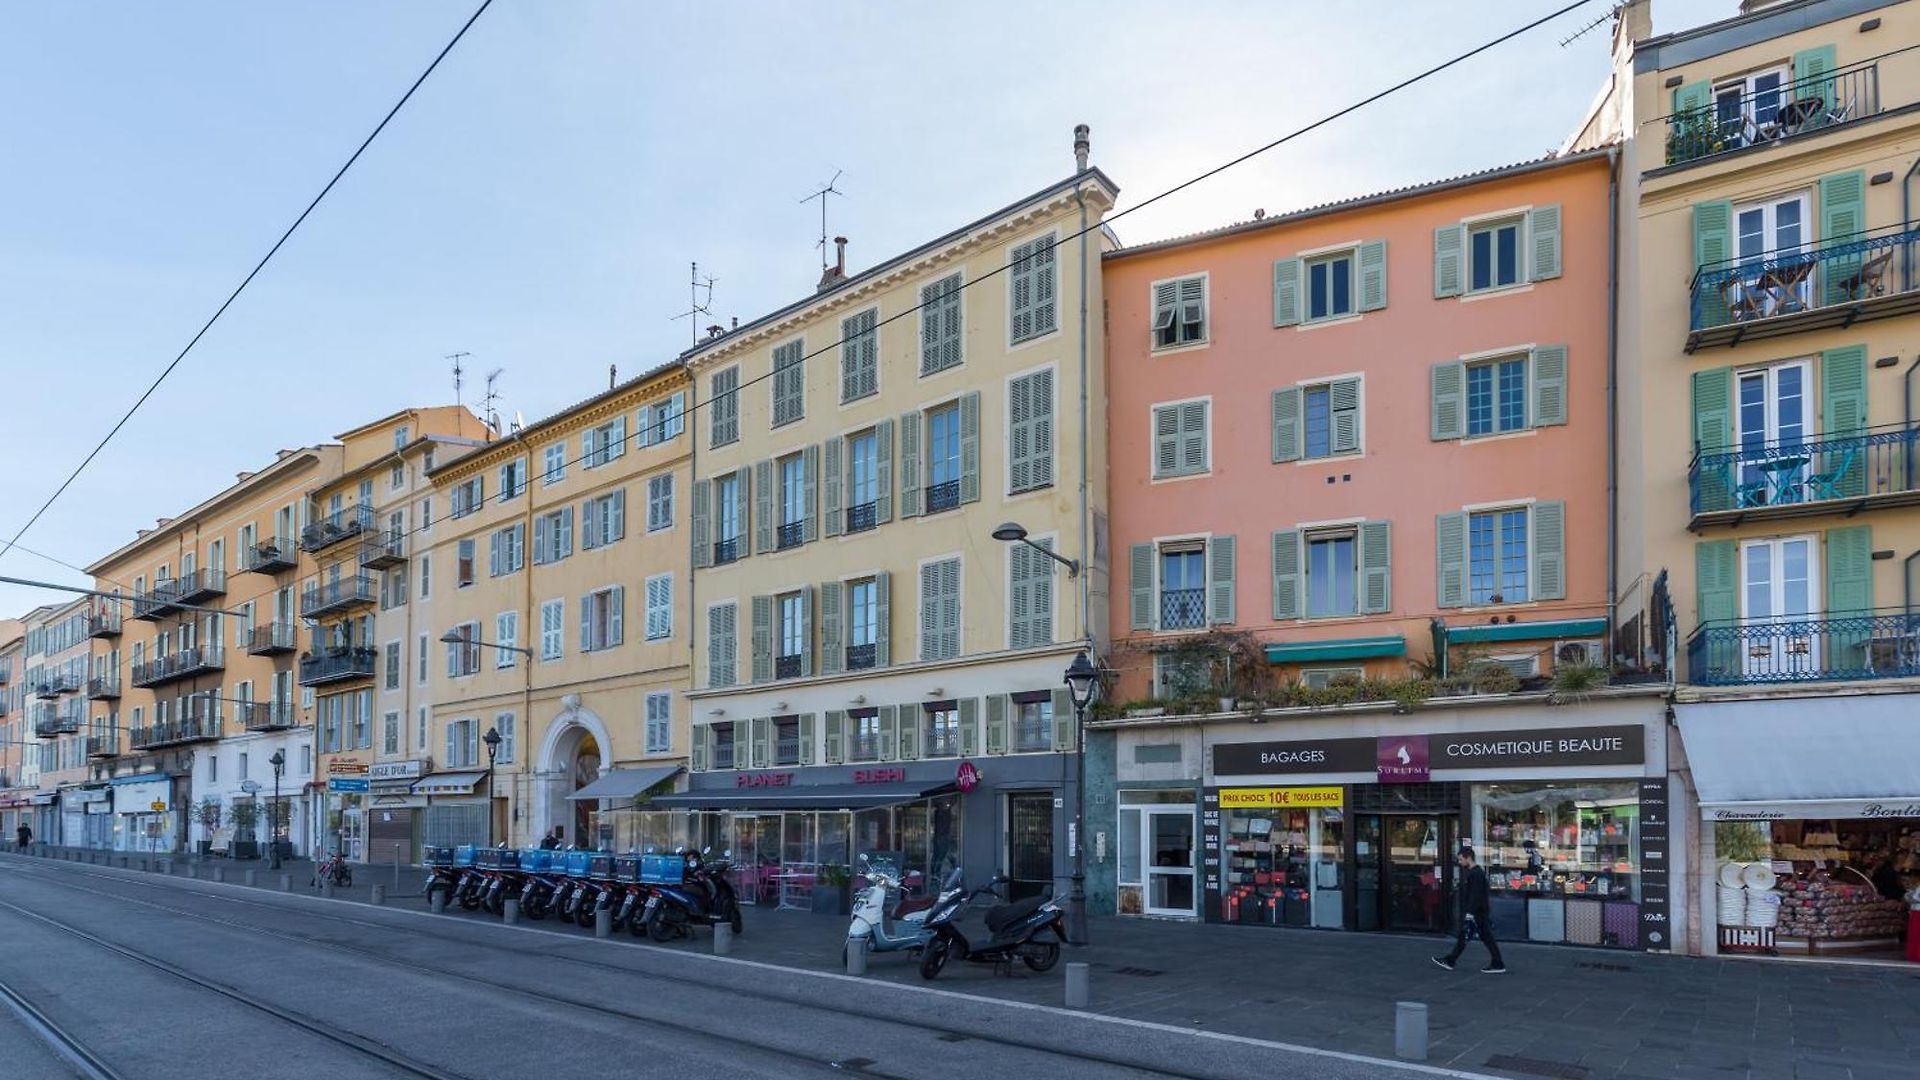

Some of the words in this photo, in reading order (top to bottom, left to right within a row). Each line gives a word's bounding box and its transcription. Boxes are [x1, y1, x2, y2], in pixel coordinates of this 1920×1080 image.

[1446, 740, 1553, 756] COSMETIQUE
[1558, 737, 1623, 752] BEAUTE
[1261, 750, 1325, 764] BAGAGES
[736, 773, 794, 788] PLANET
[853, 768, 906, 784] SUSHI
[1223, 793, 1240, 802] PRIX
[1269, 791, 1290, 804] 10€
[1293, 792, 1310, 802] TOUS
[1713, 809, 1785, 819] Charcuterie
